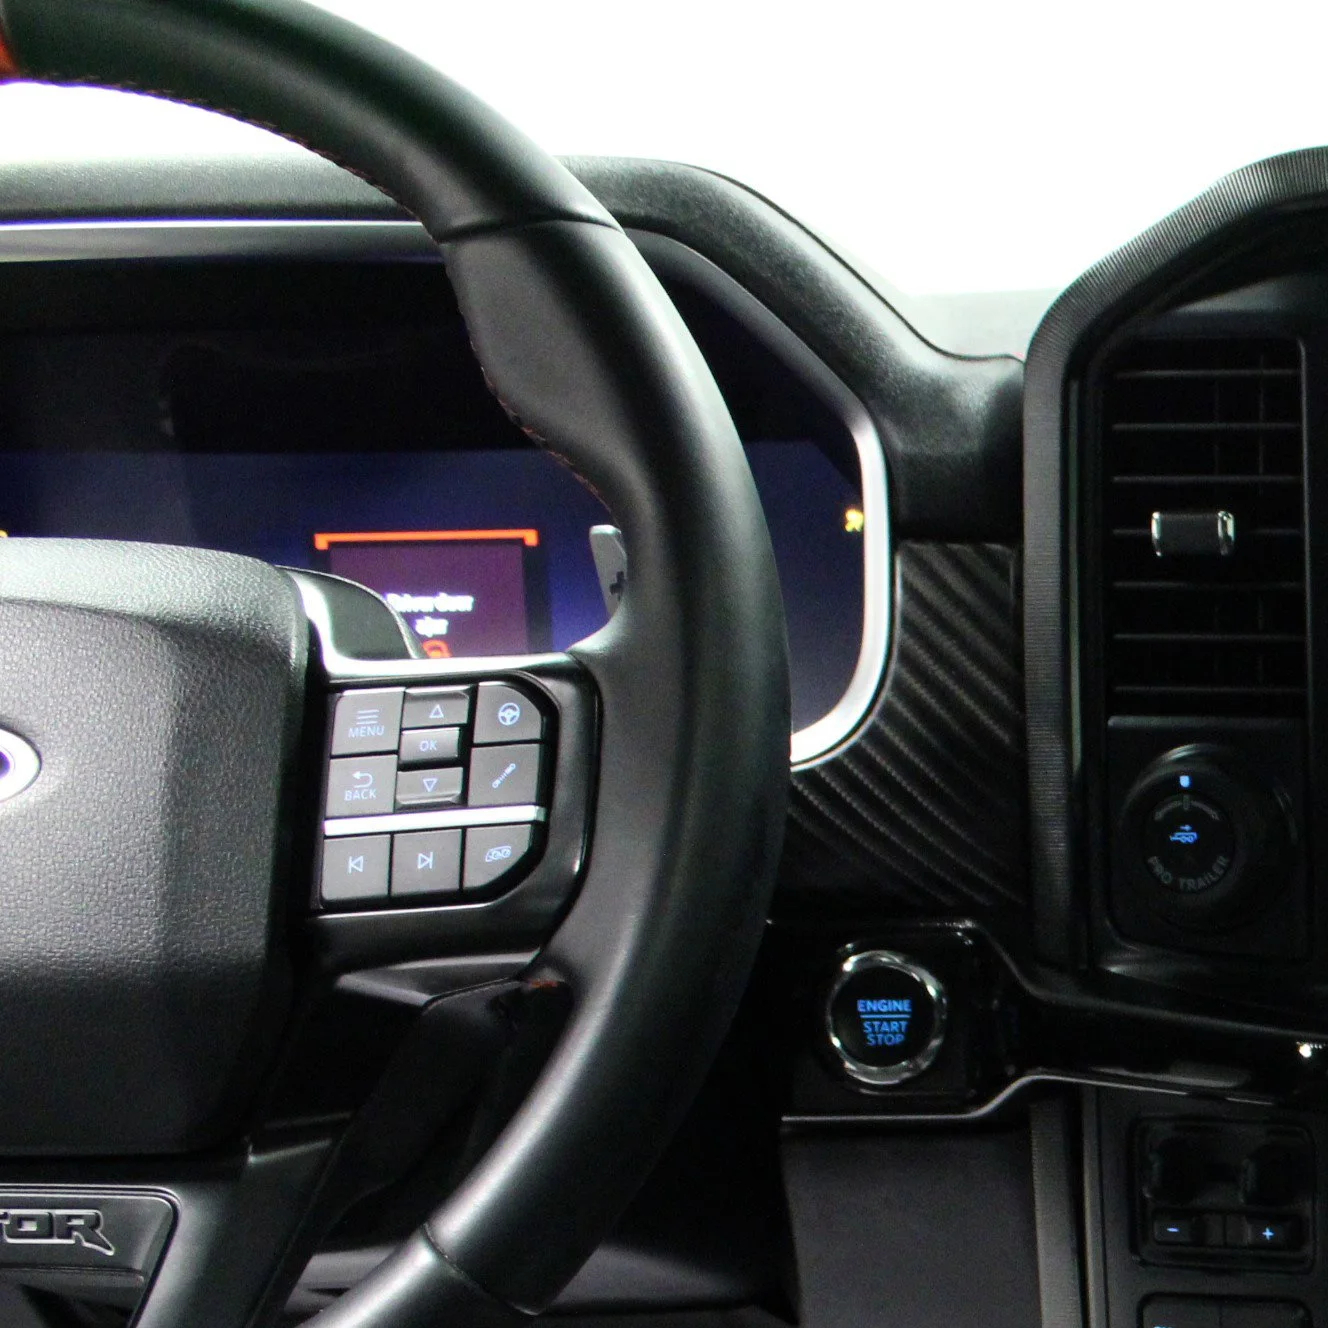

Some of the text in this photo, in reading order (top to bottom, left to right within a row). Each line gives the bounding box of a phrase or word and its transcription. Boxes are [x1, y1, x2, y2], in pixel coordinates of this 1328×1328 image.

[347, 725, 385, 739] MENU
[418, 739, 438, 752] OK
[344, 788, 377, 802] BACK
[856, 999, 913, 1012] ENGINE
[863, 1020, 908, 1034] START
[866, 1033, 906, 1046] STOP
